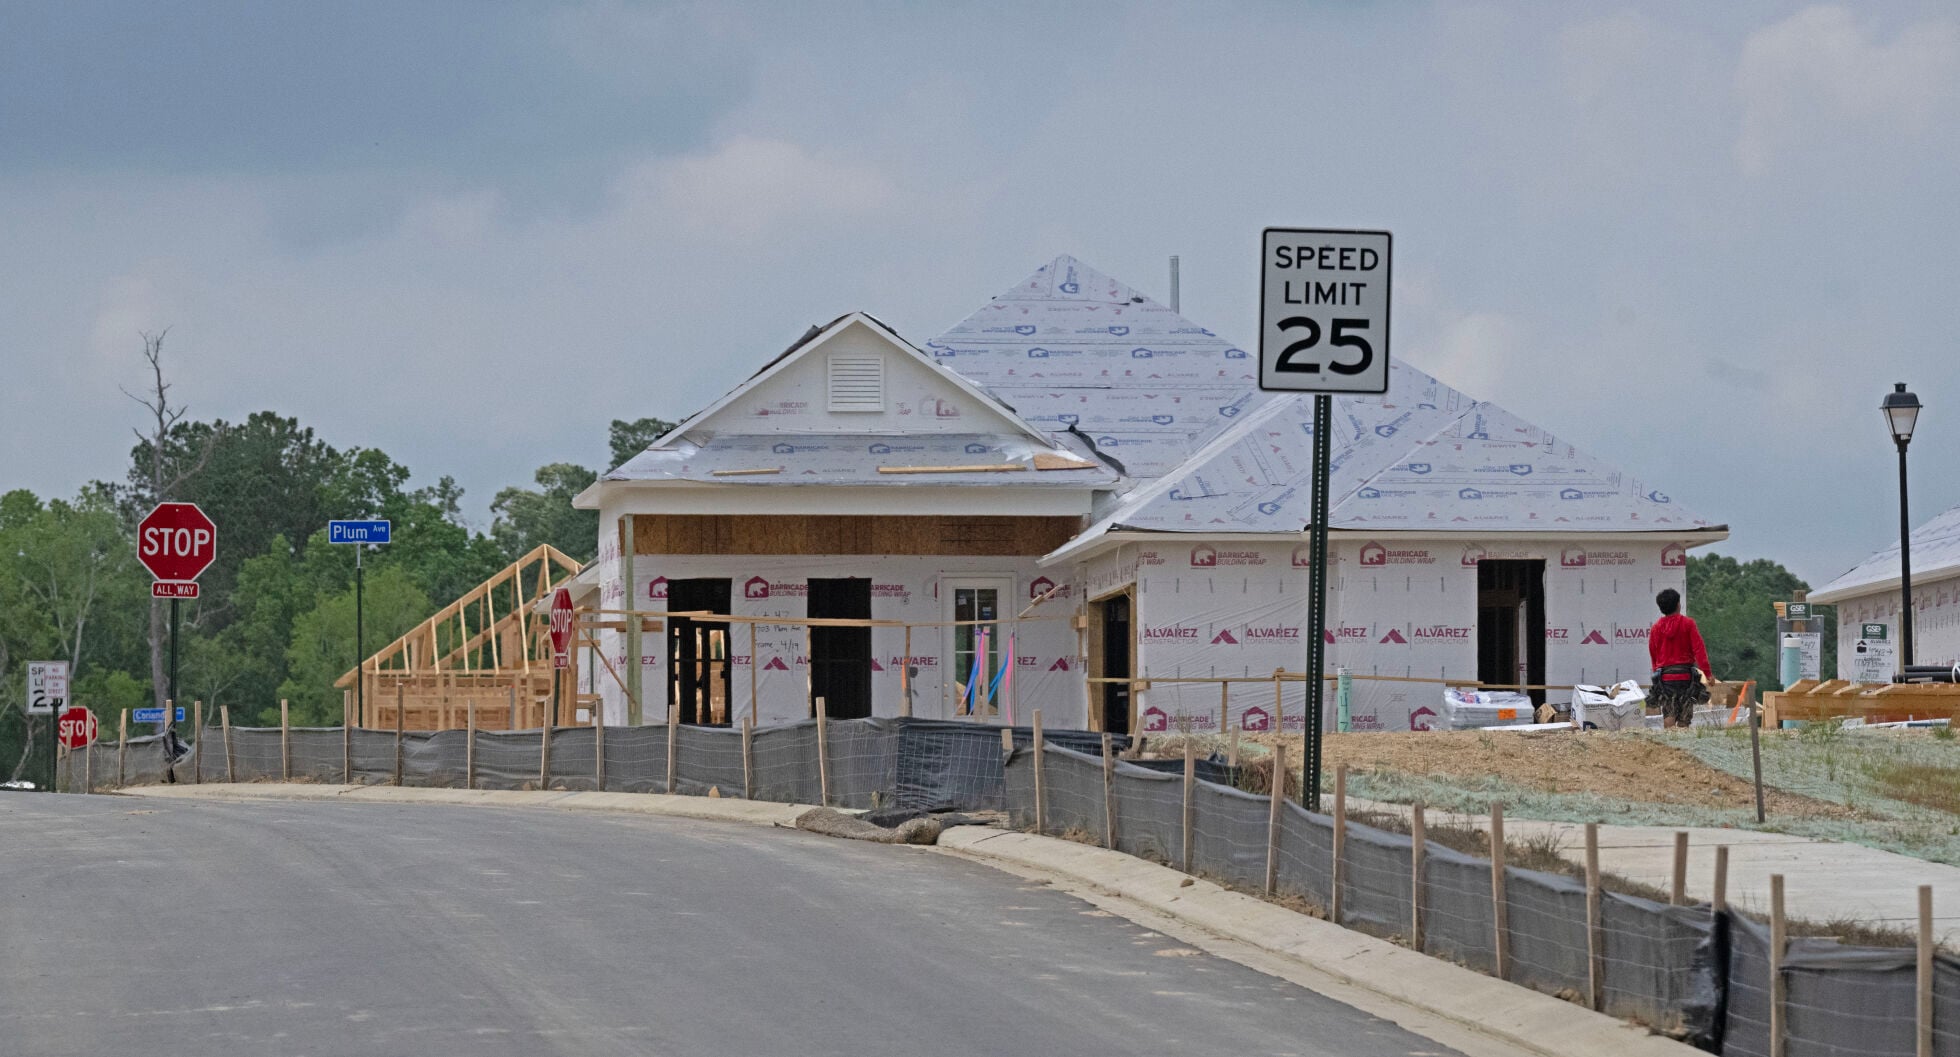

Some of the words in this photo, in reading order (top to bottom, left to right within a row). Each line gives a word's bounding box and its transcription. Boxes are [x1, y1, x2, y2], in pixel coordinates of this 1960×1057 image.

[1275, 246, 1379, 271] SPEED
[1285, 281, 1367, 306] LIMIT
[1275, 316, 1373, 376] 25
[333, 525, 368, 539] Plum
[143, 527, 210, 557] STOP
[157, 585, 172, 594] ALL
[177, 585, 195, 595] WAY
[552, 609, 573, 633] STOP
[1145, 628, 1198, 638] ALVAREZ
[1246, 628, 1299, 638] ALVAREZ
[1337, 628, 1367, 638] AREZ
[1414, 628, 1468, 638] ALVAREZ
[1615, 629, 1650, 638] ALVA
